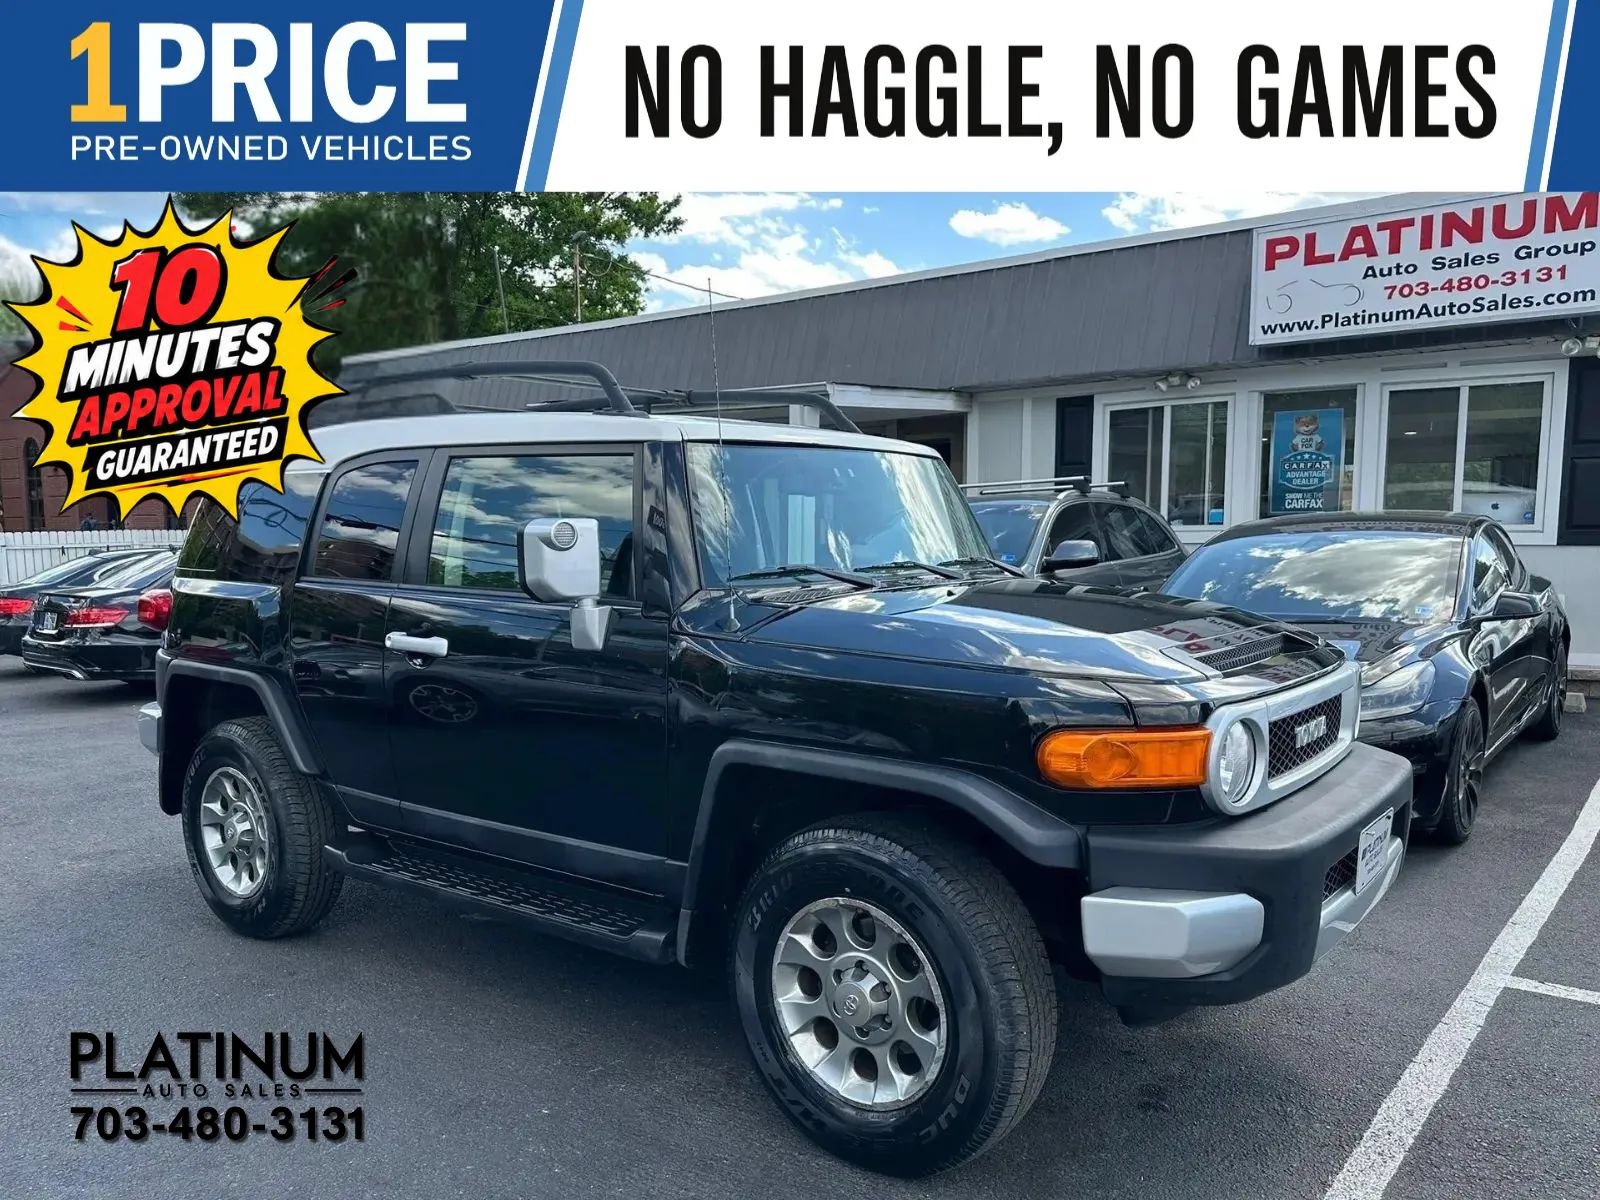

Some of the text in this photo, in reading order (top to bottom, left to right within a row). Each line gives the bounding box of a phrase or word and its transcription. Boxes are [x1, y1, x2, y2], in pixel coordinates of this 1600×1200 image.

[1264, 192, 1600, 271] PLATINUM
[1361, 239, 1597, 280] Auto Sales Group
[1383, 264, 1568, 300] 703-480-3131
[1260, 287, 1596, 336] www.PlatinumAutoSales.com
[1284, 461, 1329, 470] CARFAX
[1286, 470, 1326, 478] ADVANTAGE
[1285, 499, 1324, 509] CARFAX
